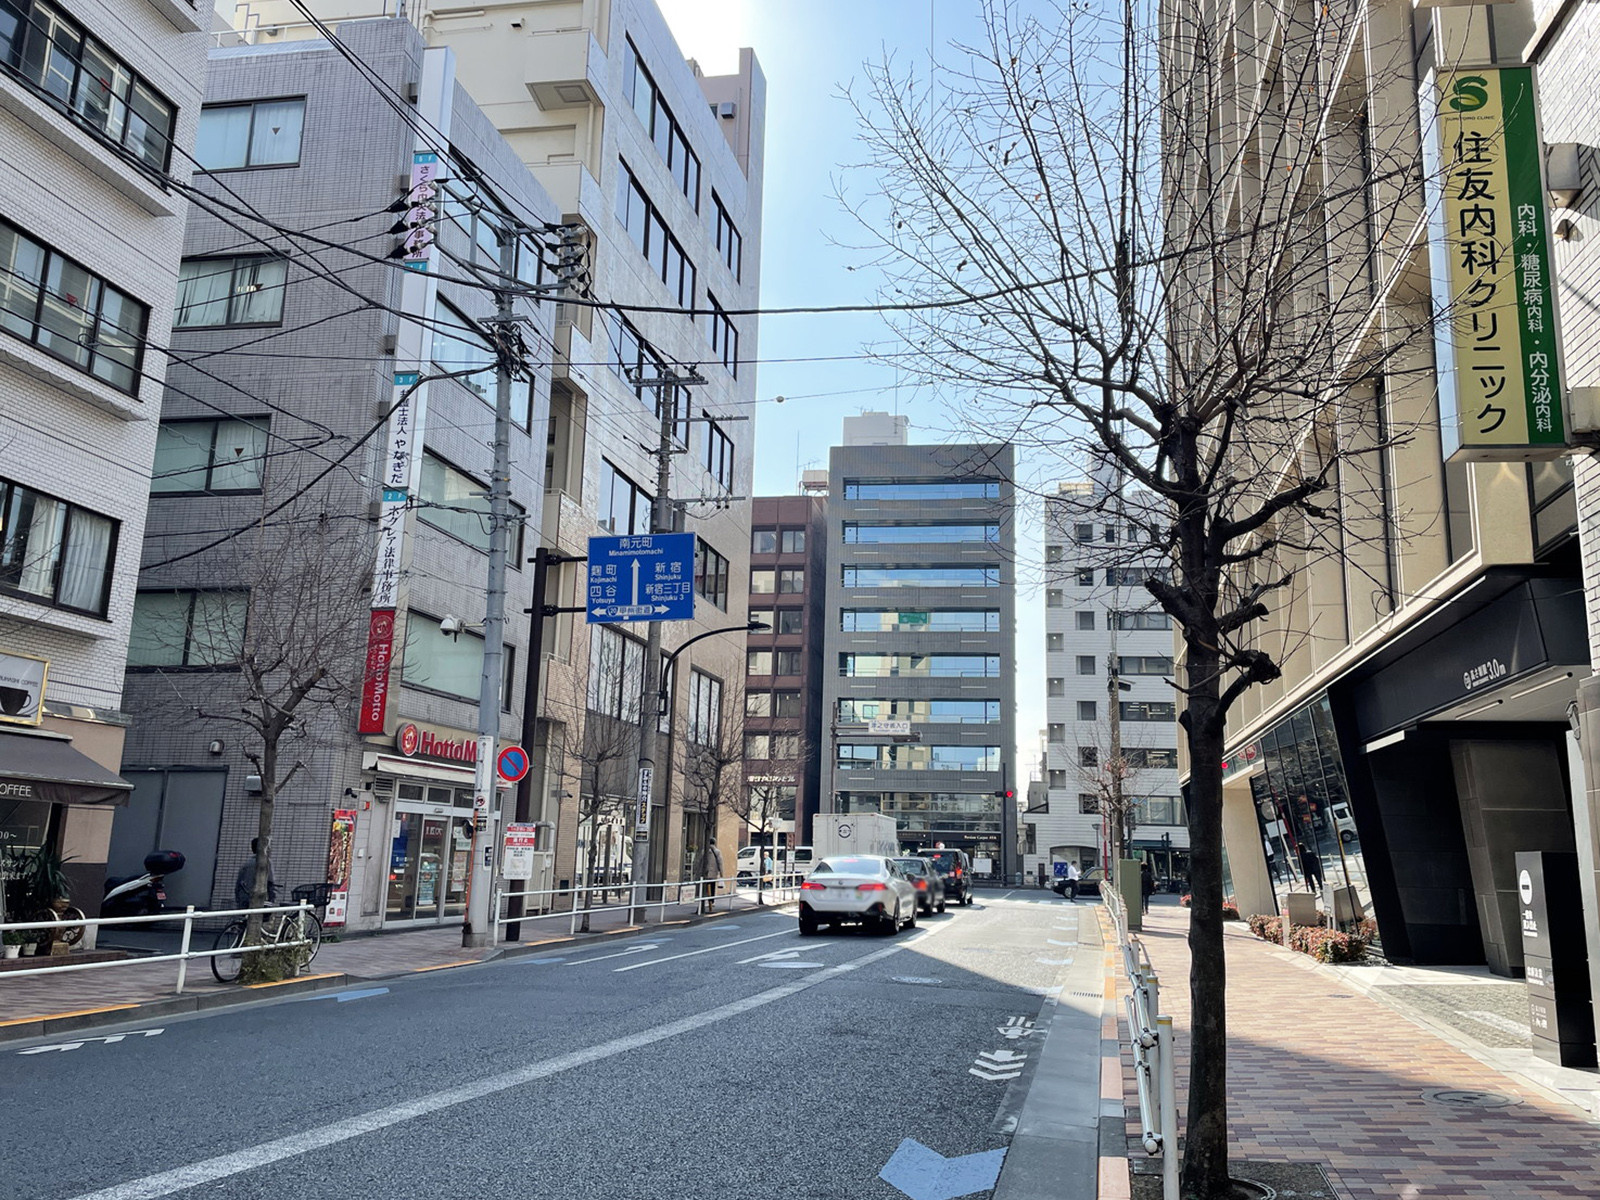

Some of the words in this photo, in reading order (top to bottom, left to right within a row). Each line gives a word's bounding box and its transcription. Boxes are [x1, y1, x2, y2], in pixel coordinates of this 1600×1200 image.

[1453, 131, 1507, 434] 住友内科クリニック
[1517, 202, 1553, 433] 内科・糖尿病内科・内分泌内科
[619, 537, 653, 549] 南元町
[608, 548, 664, 557] Minamimotomachi
[654, 562, 682, 574] 新宿
[590, 575, 617, 583] Kojimachi
[590, 585, 617, 597] 四谷
[645, 582, 691, 595] 新宿三丁目
[592, 597, 616, 605] Yotsuya
